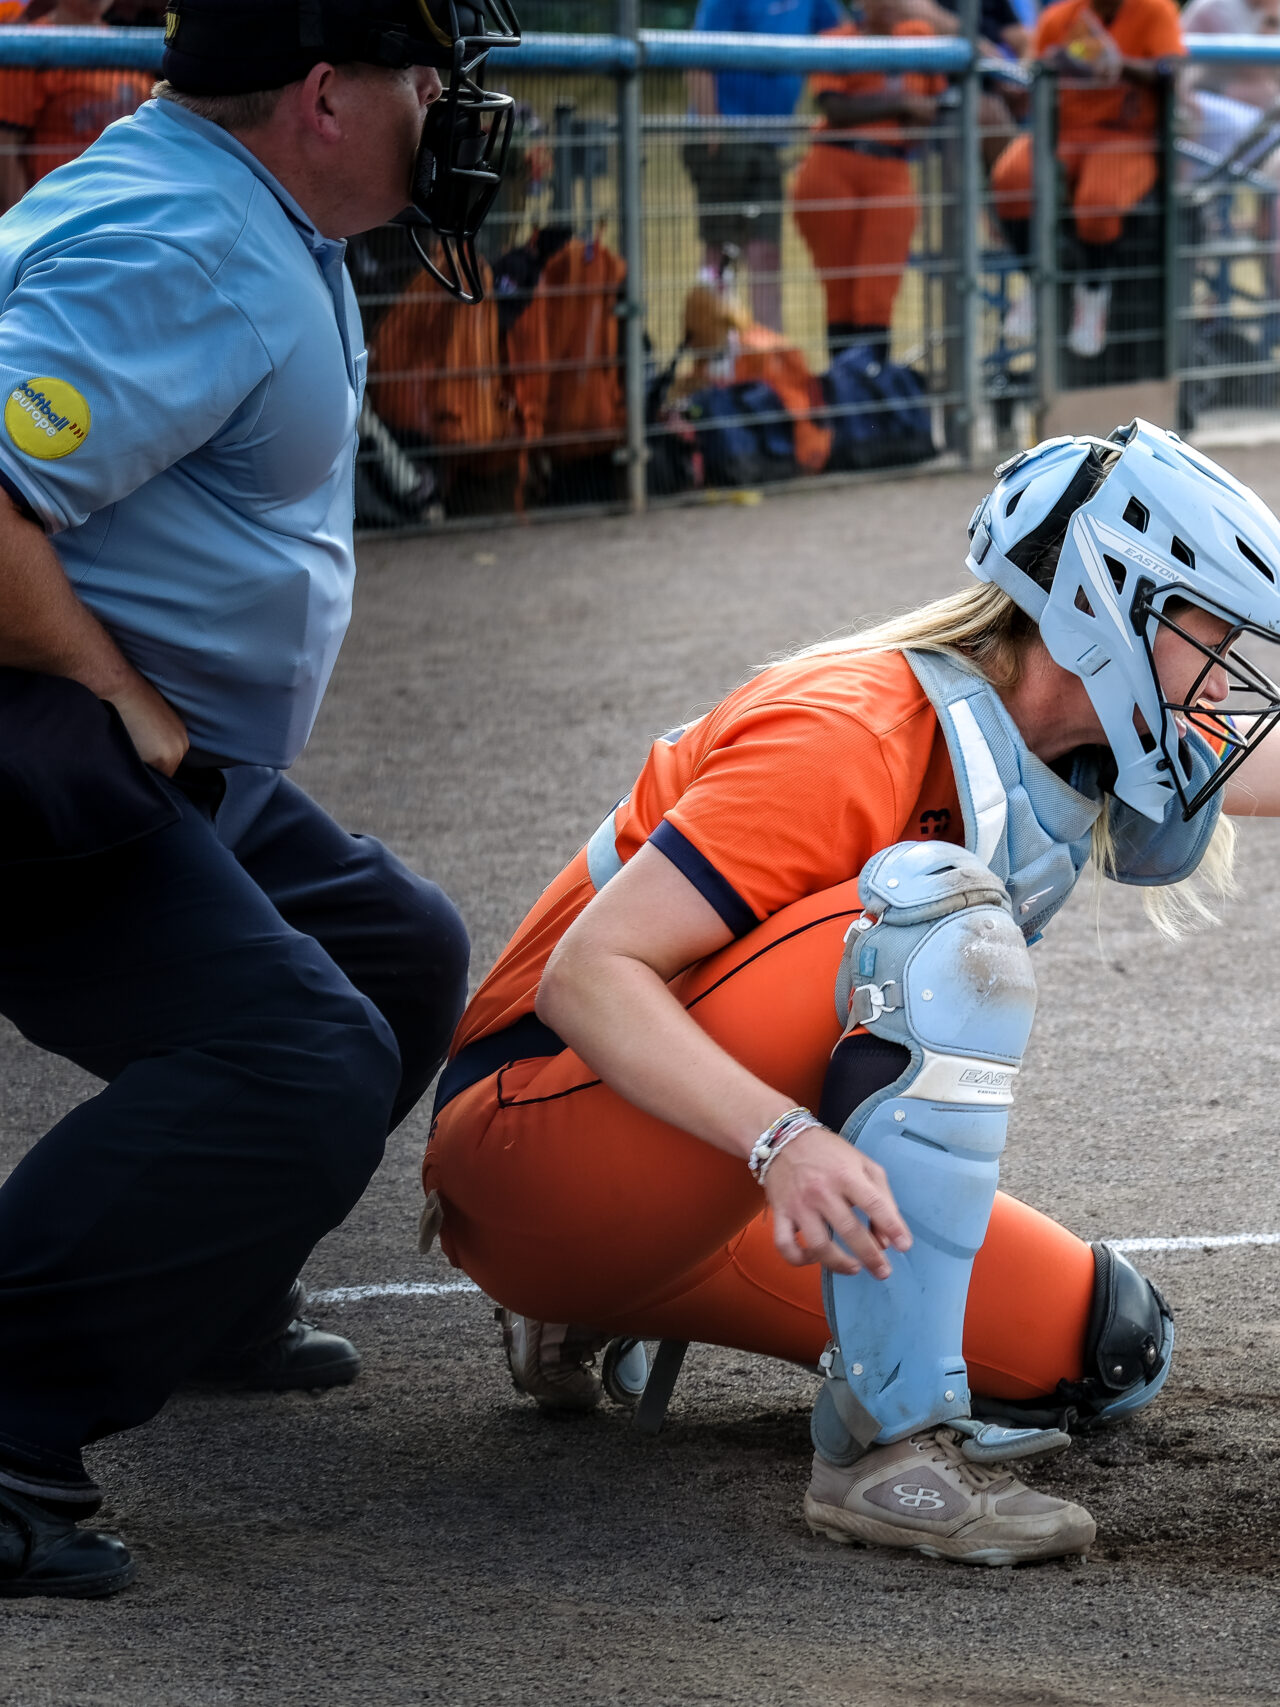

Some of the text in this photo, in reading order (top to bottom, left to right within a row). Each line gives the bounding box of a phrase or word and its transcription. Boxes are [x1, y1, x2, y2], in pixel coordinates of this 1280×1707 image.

[11, 390, 57, 437] europe
[19, 382, 70, 431] softball
[1123, 547, 1180, 582] EASTON
